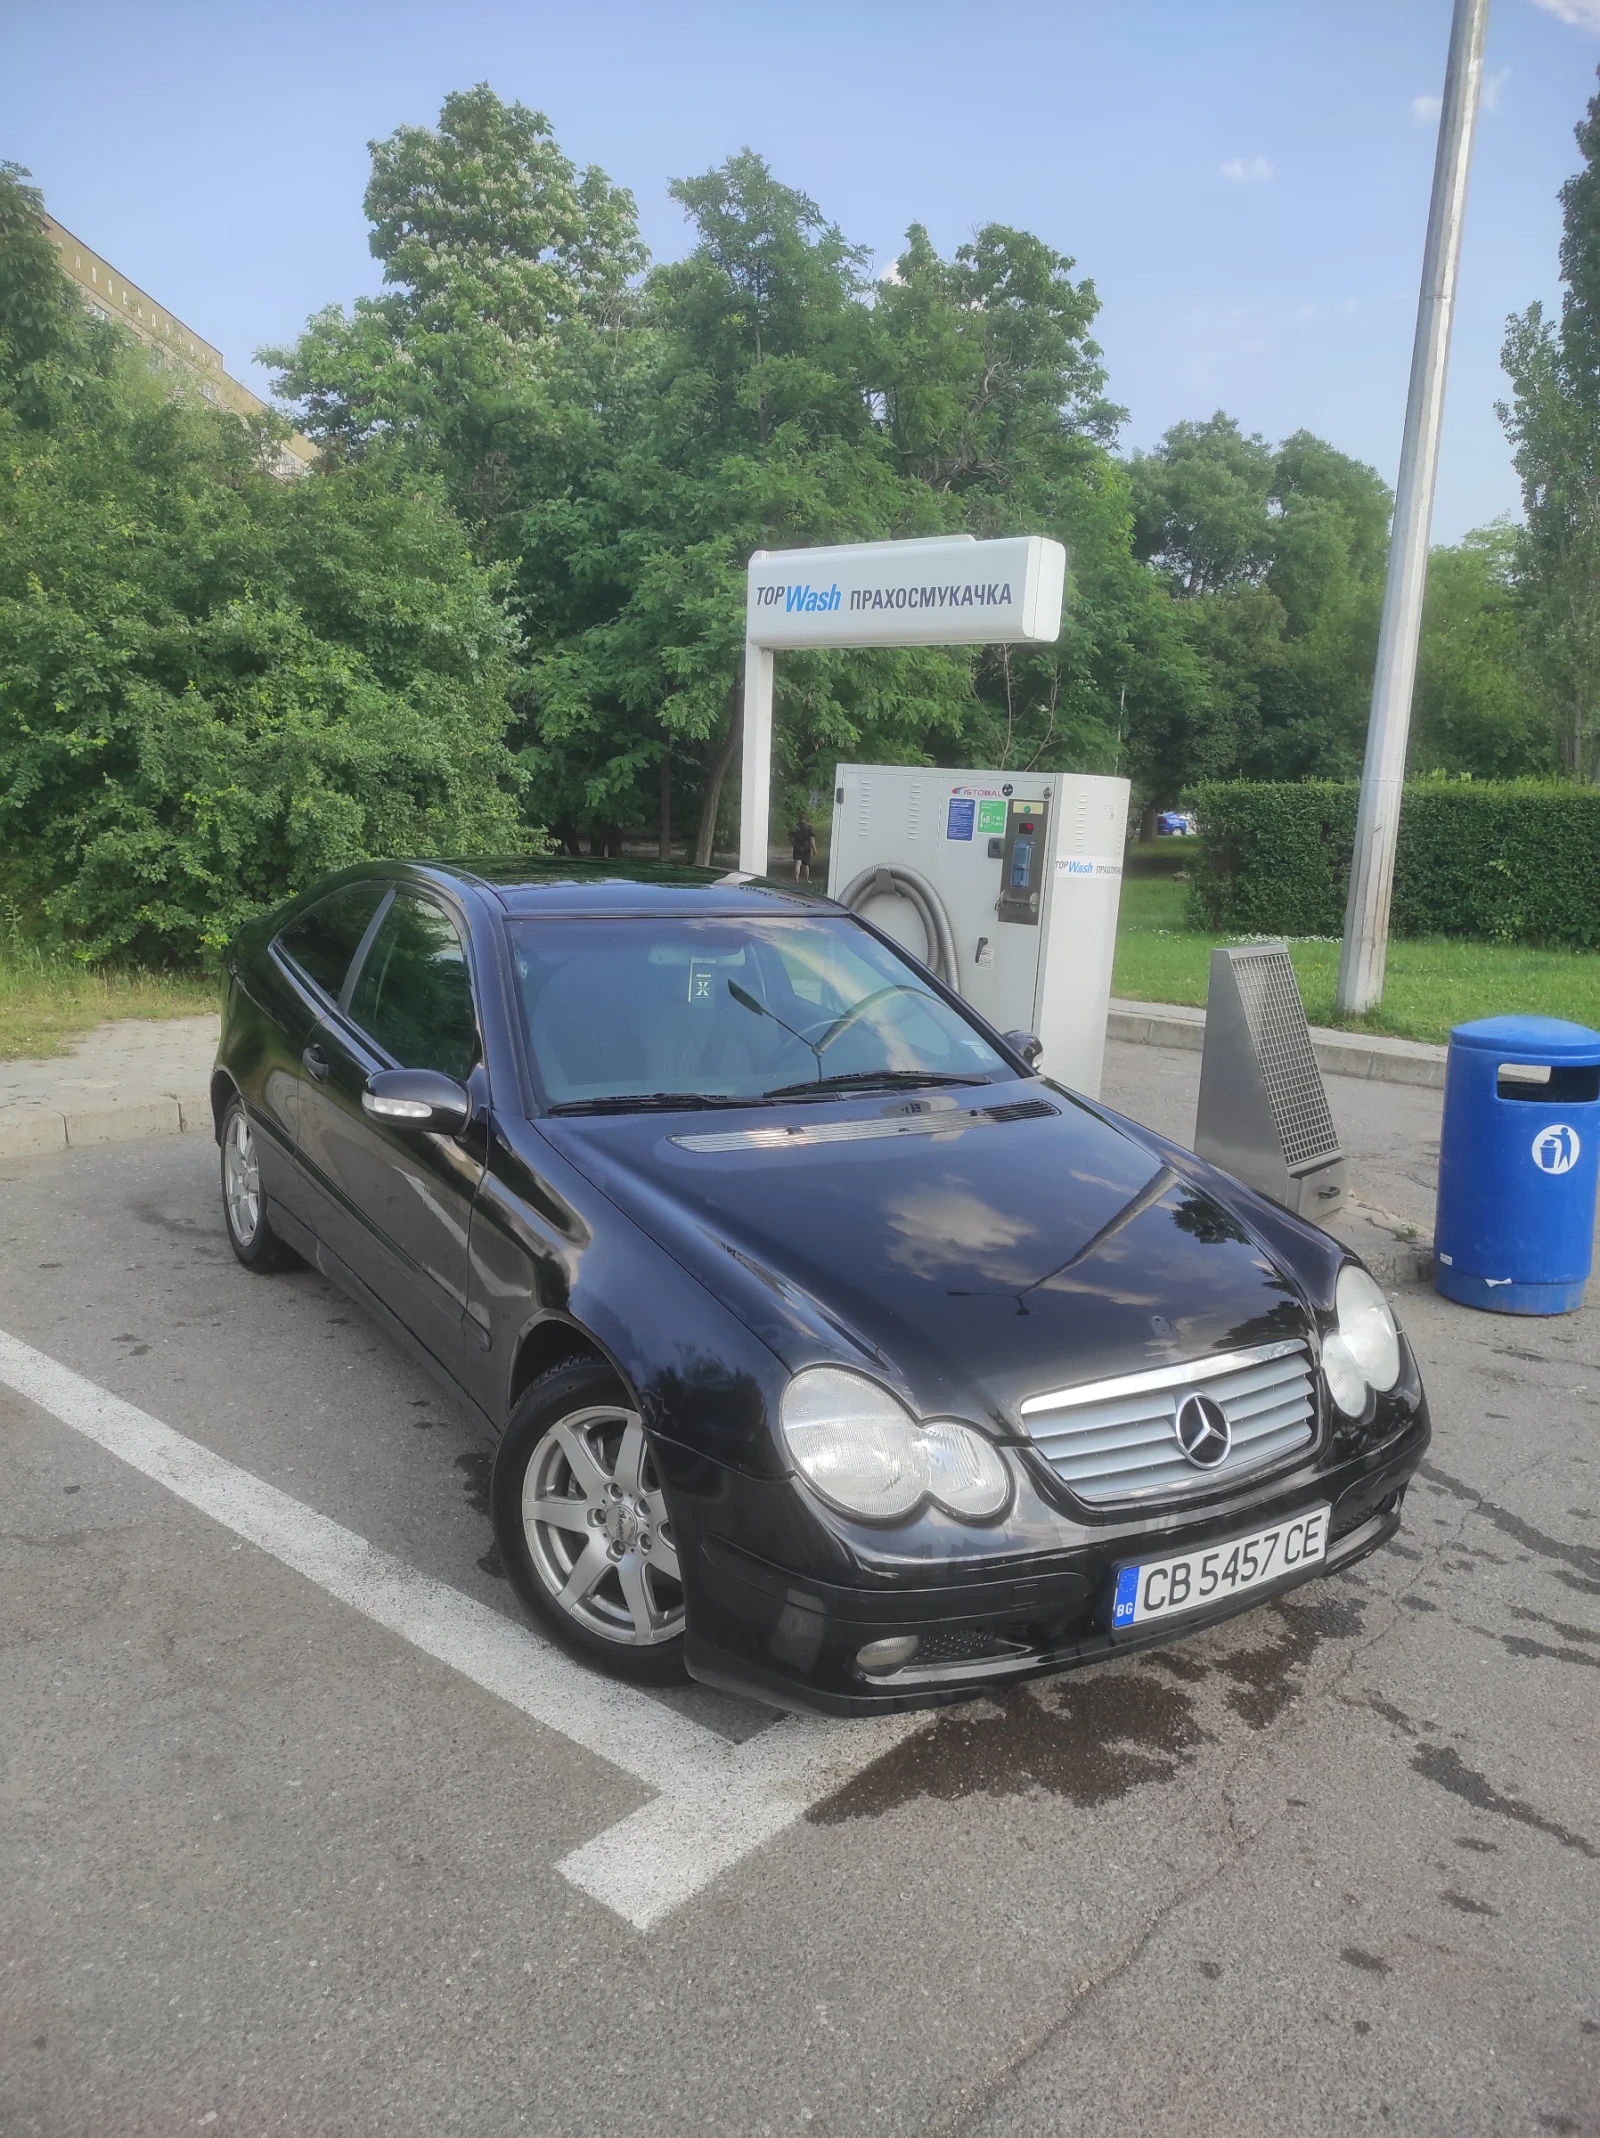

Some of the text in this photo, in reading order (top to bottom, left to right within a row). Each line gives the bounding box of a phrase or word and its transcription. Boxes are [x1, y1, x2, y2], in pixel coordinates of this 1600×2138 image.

[850, 583, 1012, 611] ПРАХОСМУКАЧКА
[963, 788, 1003, 797] ISTOBAL
[1143, 1515, 1323, 1612] CB 5457 CE
[1116, 1601, 1134, 1617] BG
